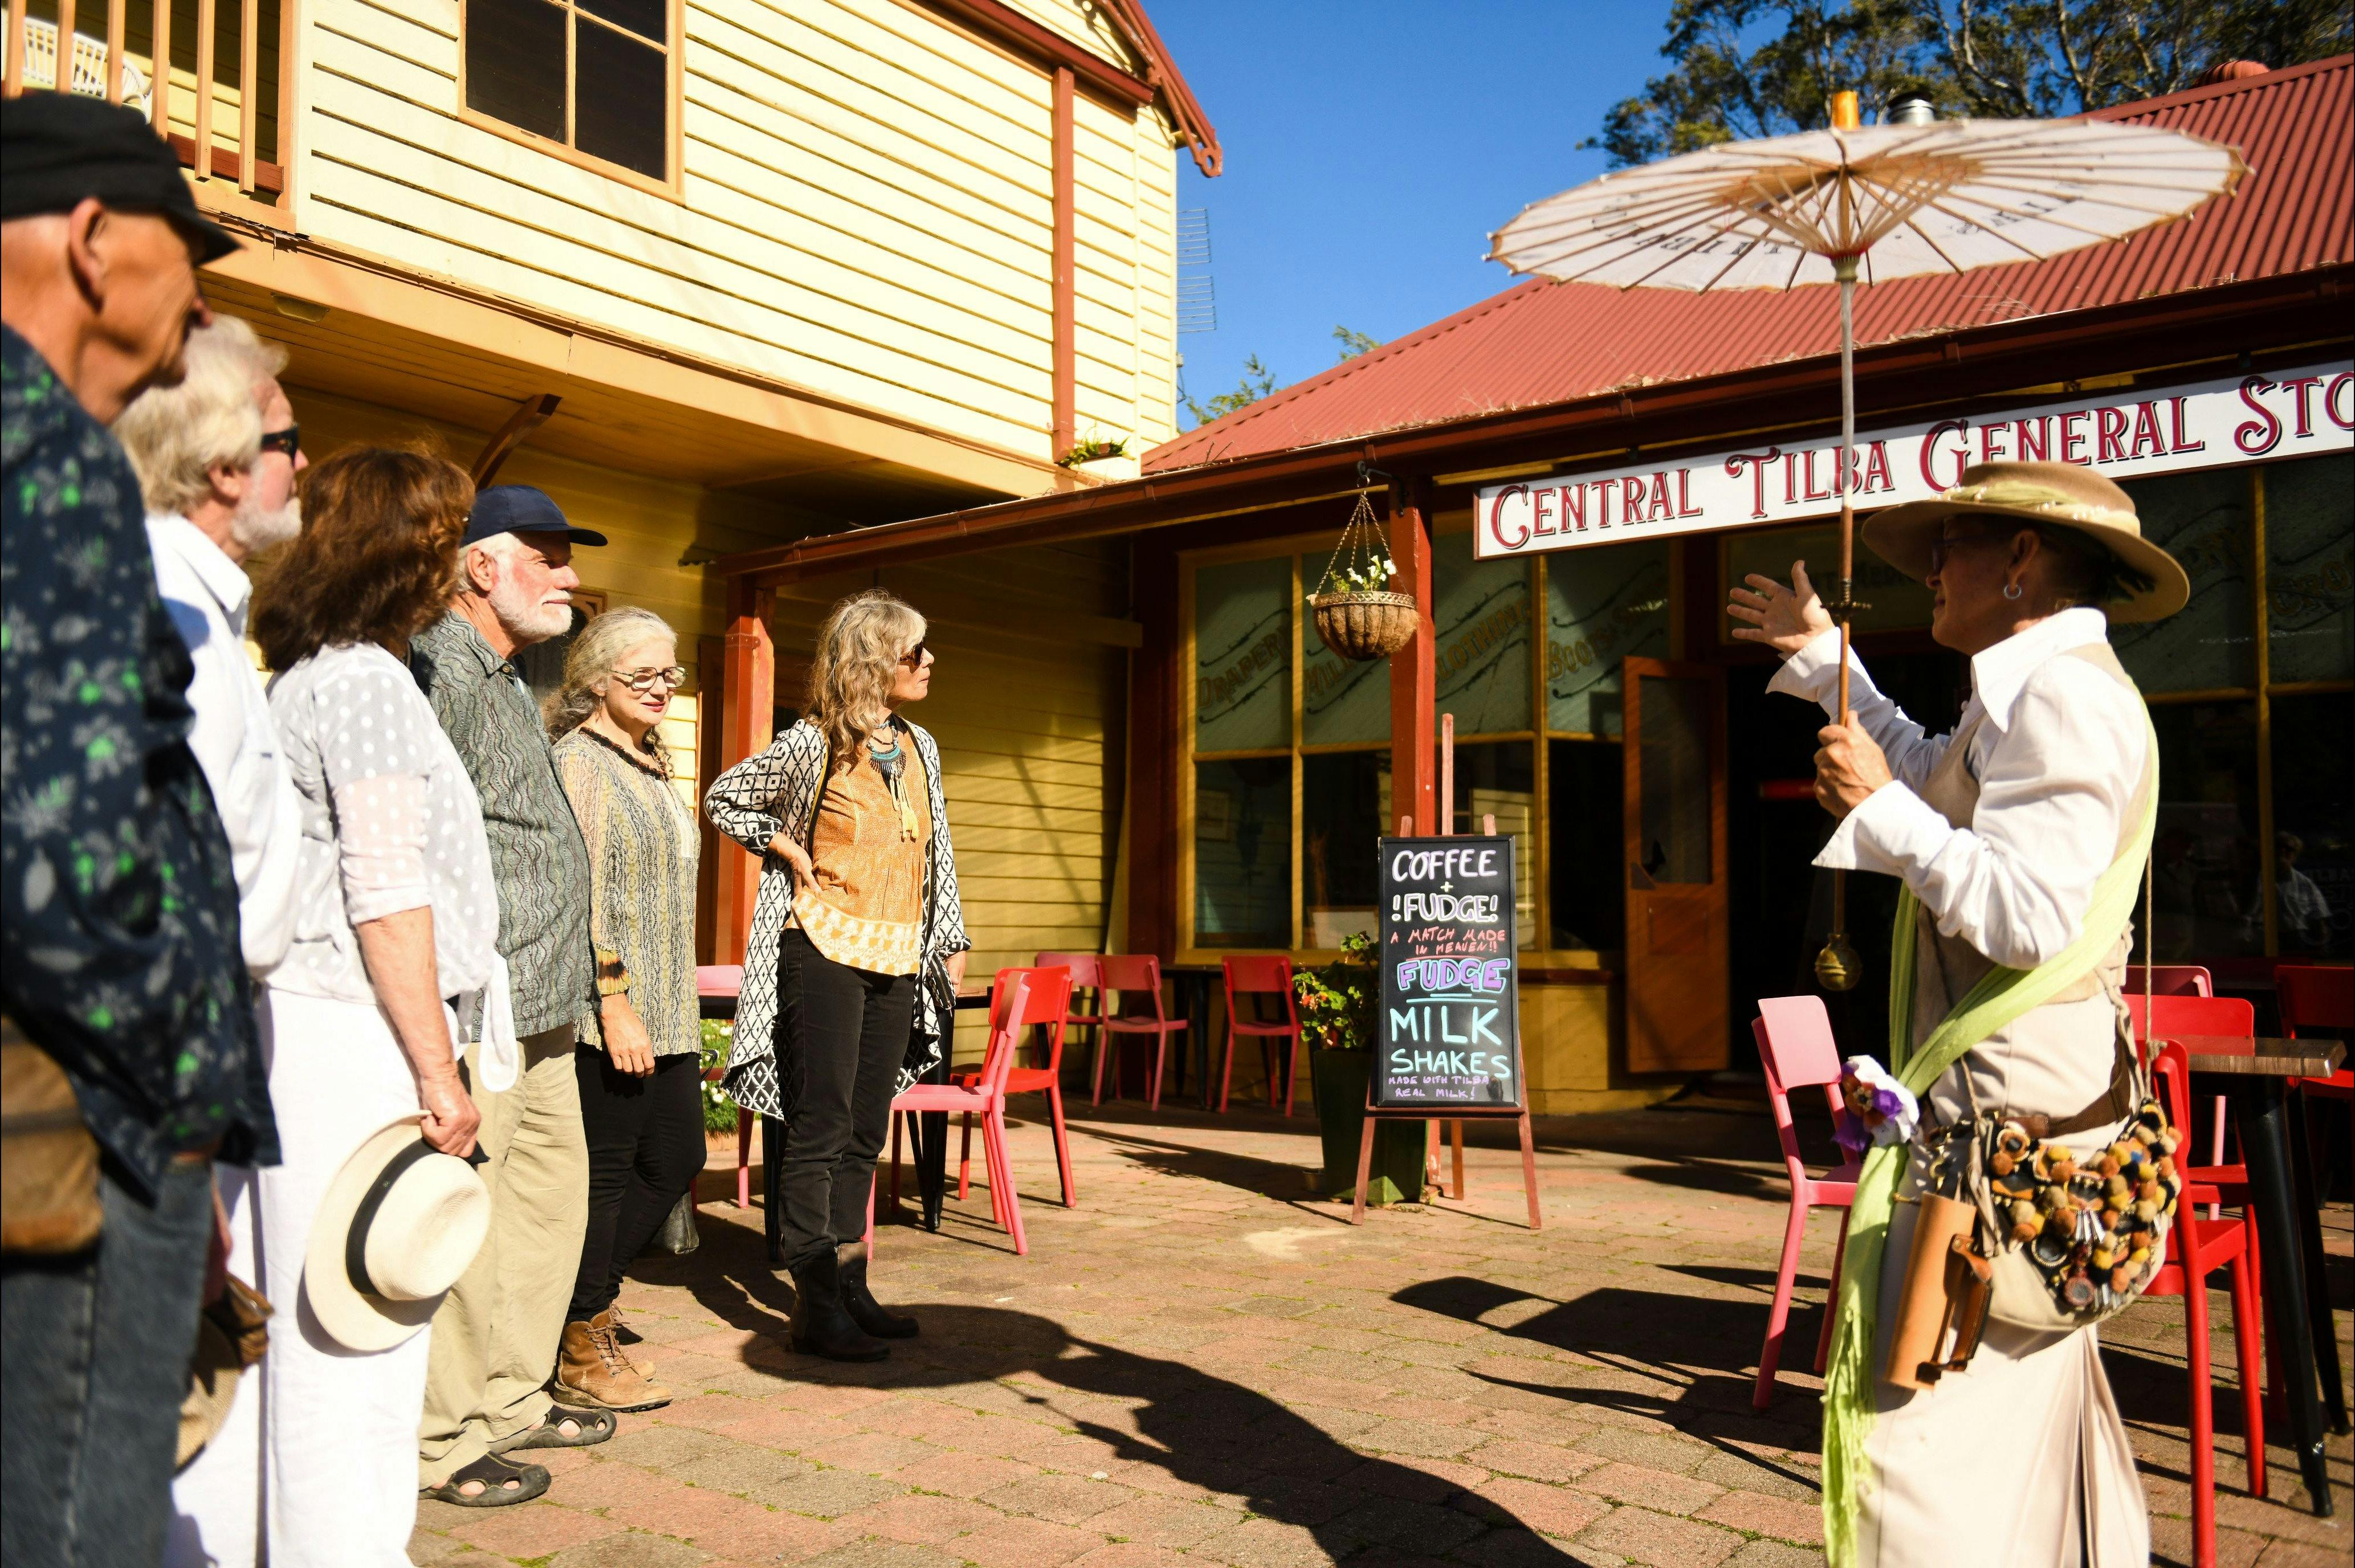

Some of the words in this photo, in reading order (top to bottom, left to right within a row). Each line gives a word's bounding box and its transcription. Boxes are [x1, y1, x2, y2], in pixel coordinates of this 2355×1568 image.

[1490, 468, 1703, 550] CENTRAL
[1724, 439, 1895, 519] TILBA
[1919, 396, 2205, 493] GENERAL
[1392, 848, 1498, 881] COFFEE
[1391, 892, 1498, 922] !FUDGE!
[1390, 932, 1399, 944] A
[1408, 926, 1456, 943] MATCH
[1462, 929, 1506, 941] MADE
[1415, 944, 1427, 955] IN
[1397, 958, 1510, 994] FUDGE
[1390, 1005, 1502, 1046] MILK
[1390, 1048, 1510, 1078] SHAKES
[1388, 1075, 1418, 1085] MADE
[1423, 1075, 1448, 1085] WITH
[1451, 1075, 1489, 1085] TILBA
[1395, 1087, 1425, 1097] REAL
[1435, 1085, 1476, 1100] MILK!
